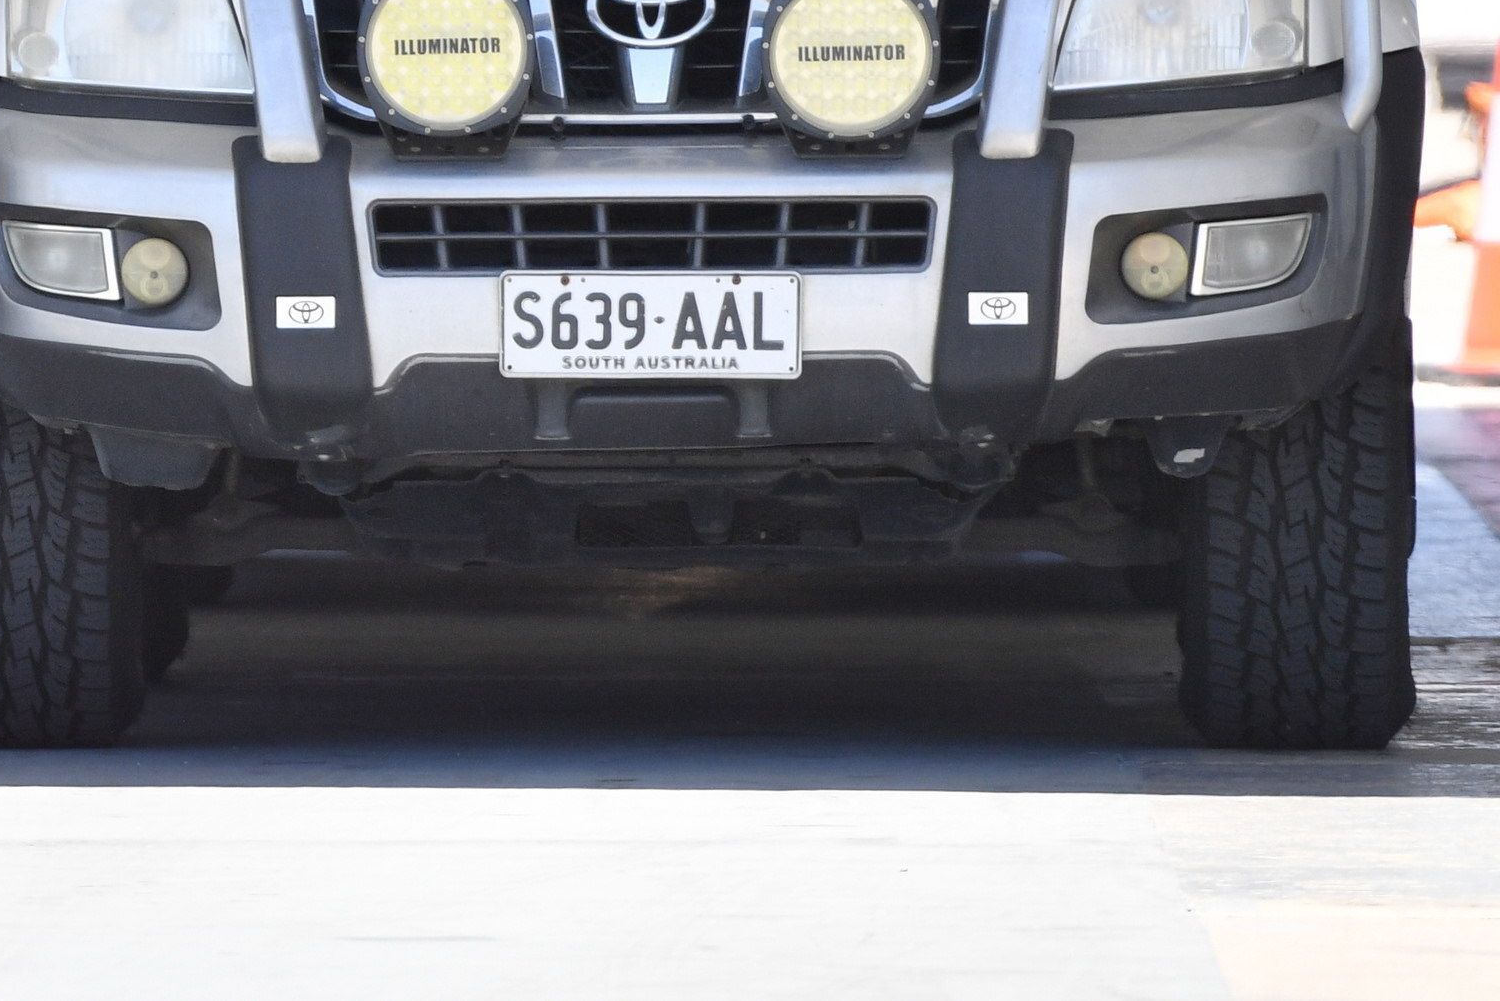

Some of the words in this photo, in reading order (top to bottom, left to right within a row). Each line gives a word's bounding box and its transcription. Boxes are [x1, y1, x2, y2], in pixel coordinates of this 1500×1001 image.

[394, 37, 501, 56] ILLUMINATOR
[798, 44, 906, 62] ILLUMINATOR
[562, 356, 626, 370] SOUTH
[635, 356, 740, 370] AUSTRALIA
